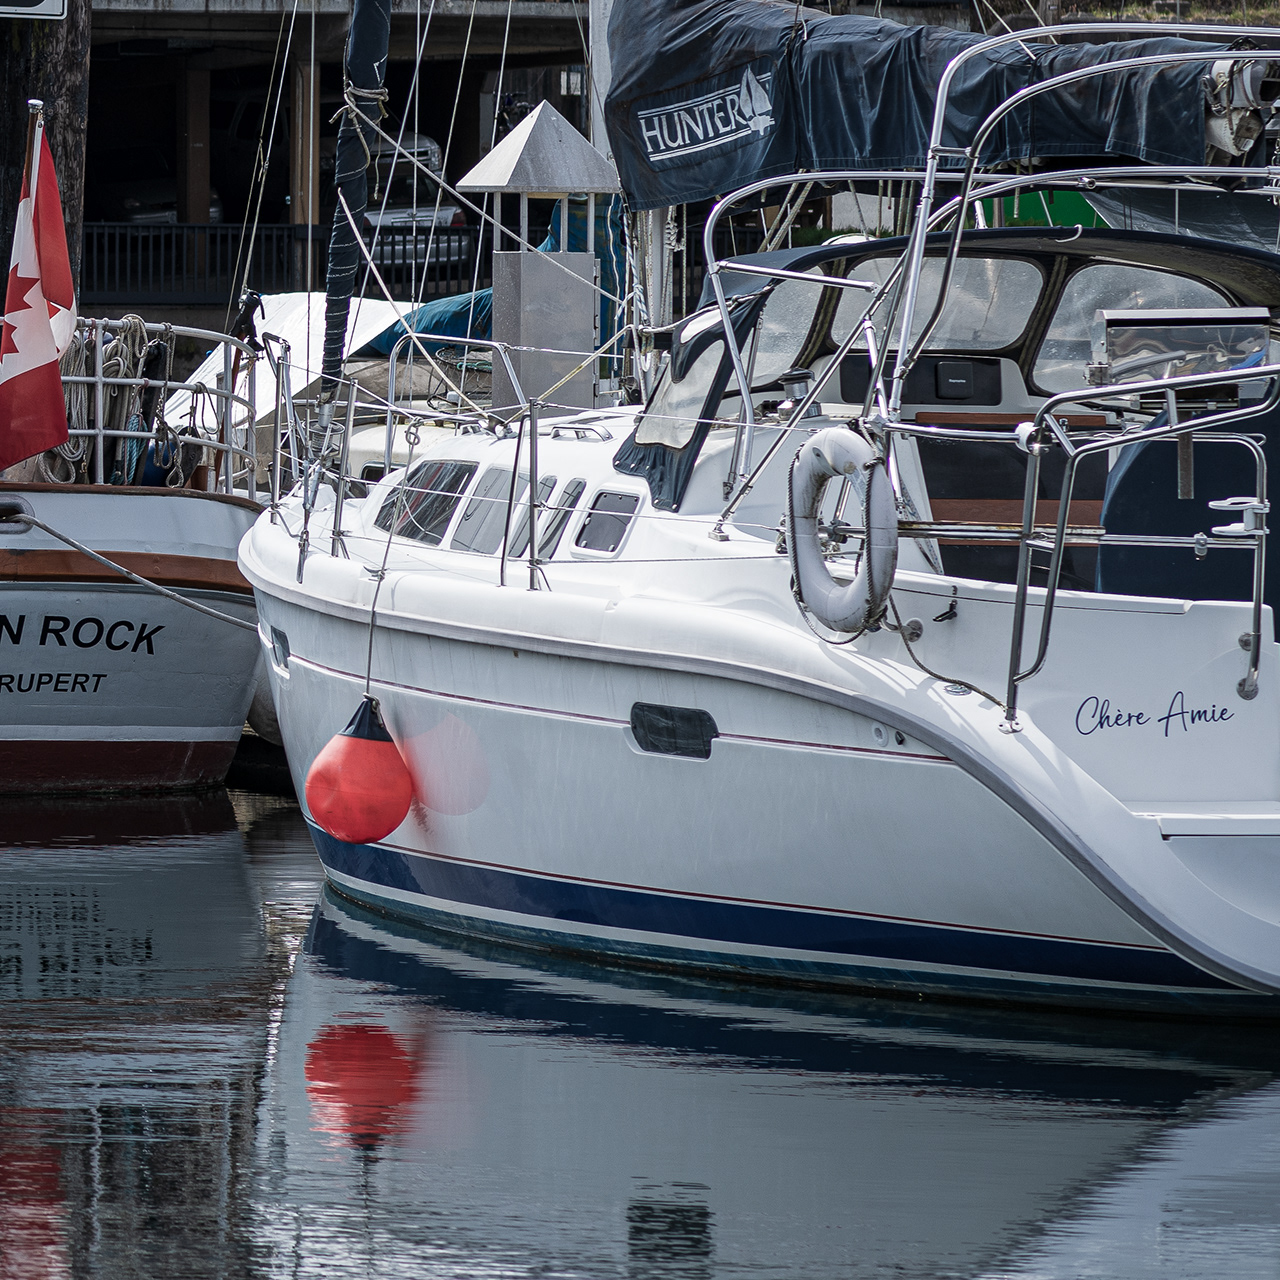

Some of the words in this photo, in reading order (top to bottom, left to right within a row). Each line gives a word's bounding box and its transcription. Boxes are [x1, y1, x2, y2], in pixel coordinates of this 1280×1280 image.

[640, 94, 747, 153] HUNTER
[38, 616, 166, 656] ROCK
[1075, 696, 1151, 736] Chère
[1157, 690, 1235, 737] Amie
